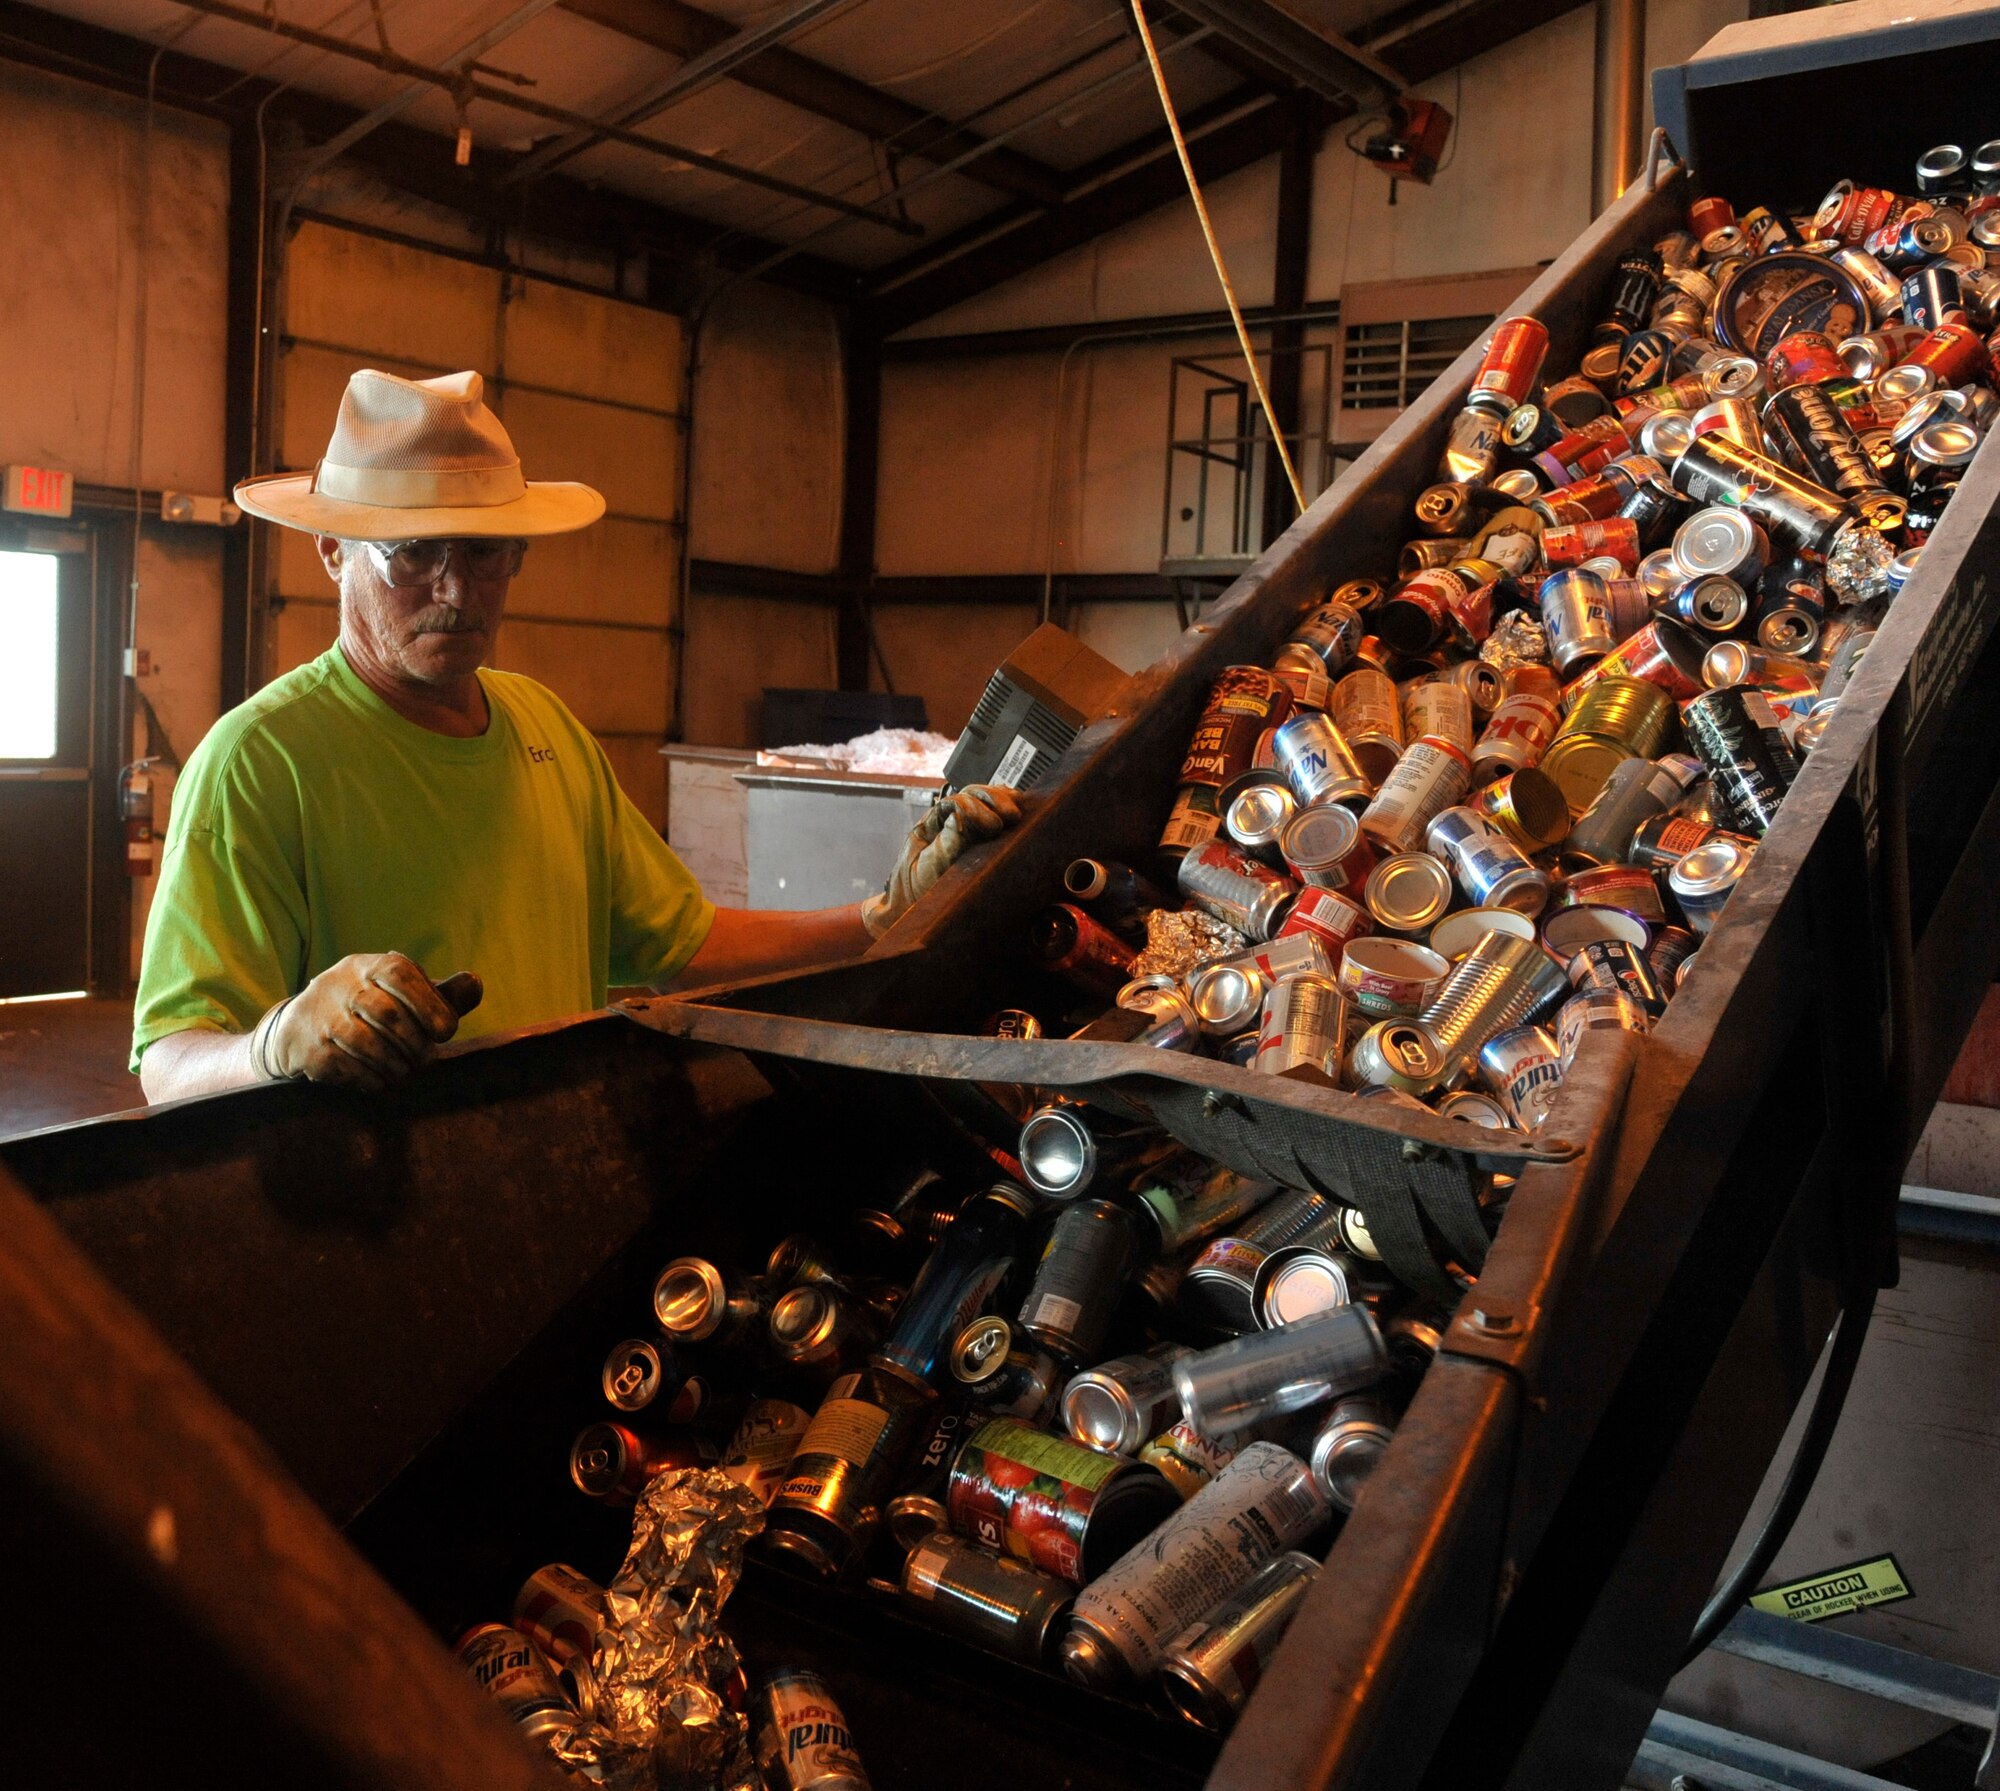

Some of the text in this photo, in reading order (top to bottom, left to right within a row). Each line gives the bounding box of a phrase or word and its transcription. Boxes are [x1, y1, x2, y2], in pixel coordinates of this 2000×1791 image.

[1786, 284, 1829, 313] DANSK
[20, 467, 64, 510] EXIT
[1361, 998, 1392, 1011] SHREDS
[922, 1414, 958, 1467] zero
[1786, 1575, 1864, 1607] CAUTION
[1812, 1604, 1824, 1615] OF
[1825, 1596, 1854, 1612] ROCKER
[1855, 1590, 1880, 1602] WHEN
[1881, 1583, 1904, 1598] USING
